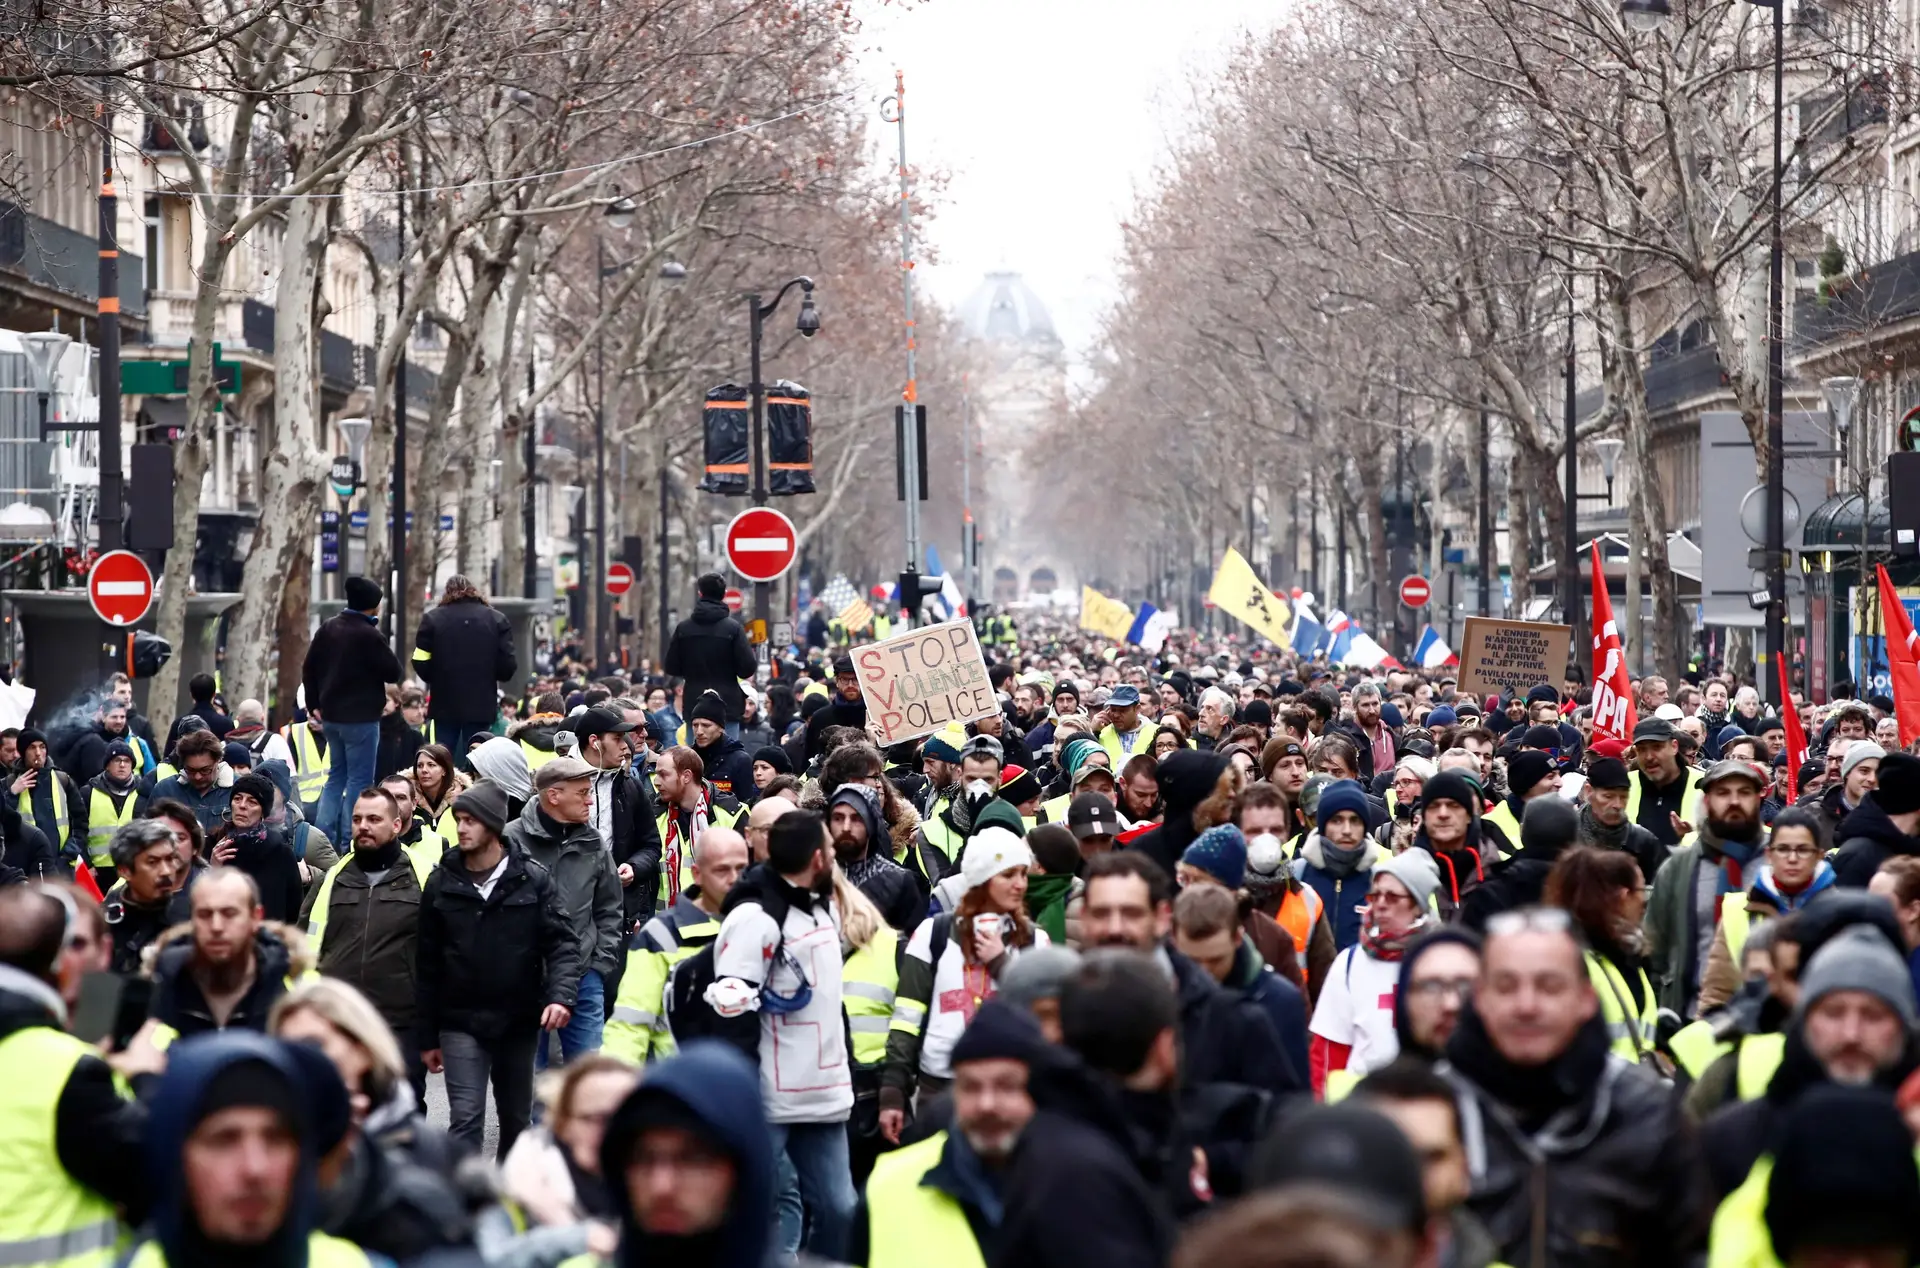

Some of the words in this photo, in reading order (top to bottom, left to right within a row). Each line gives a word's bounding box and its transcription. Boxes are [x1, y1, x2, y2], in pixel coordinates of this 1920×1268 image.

[1496, 629, 1540, 638] L'ENNEMI
[1485, 636, 1528, 645] N'ARRIVE
[860, 627, 968, 682] STOP
[1507, 645, 1546, 655] BATEAU,
[1504, 652, 1538, 661] ARRIVE
[1475, 669, 1520, 679] PAVILLON
[1522, 673, 1549, 682] POUR
[867, 660, 983, 710] VIOLENCE
[880, 688, 991, 741] POLICE
